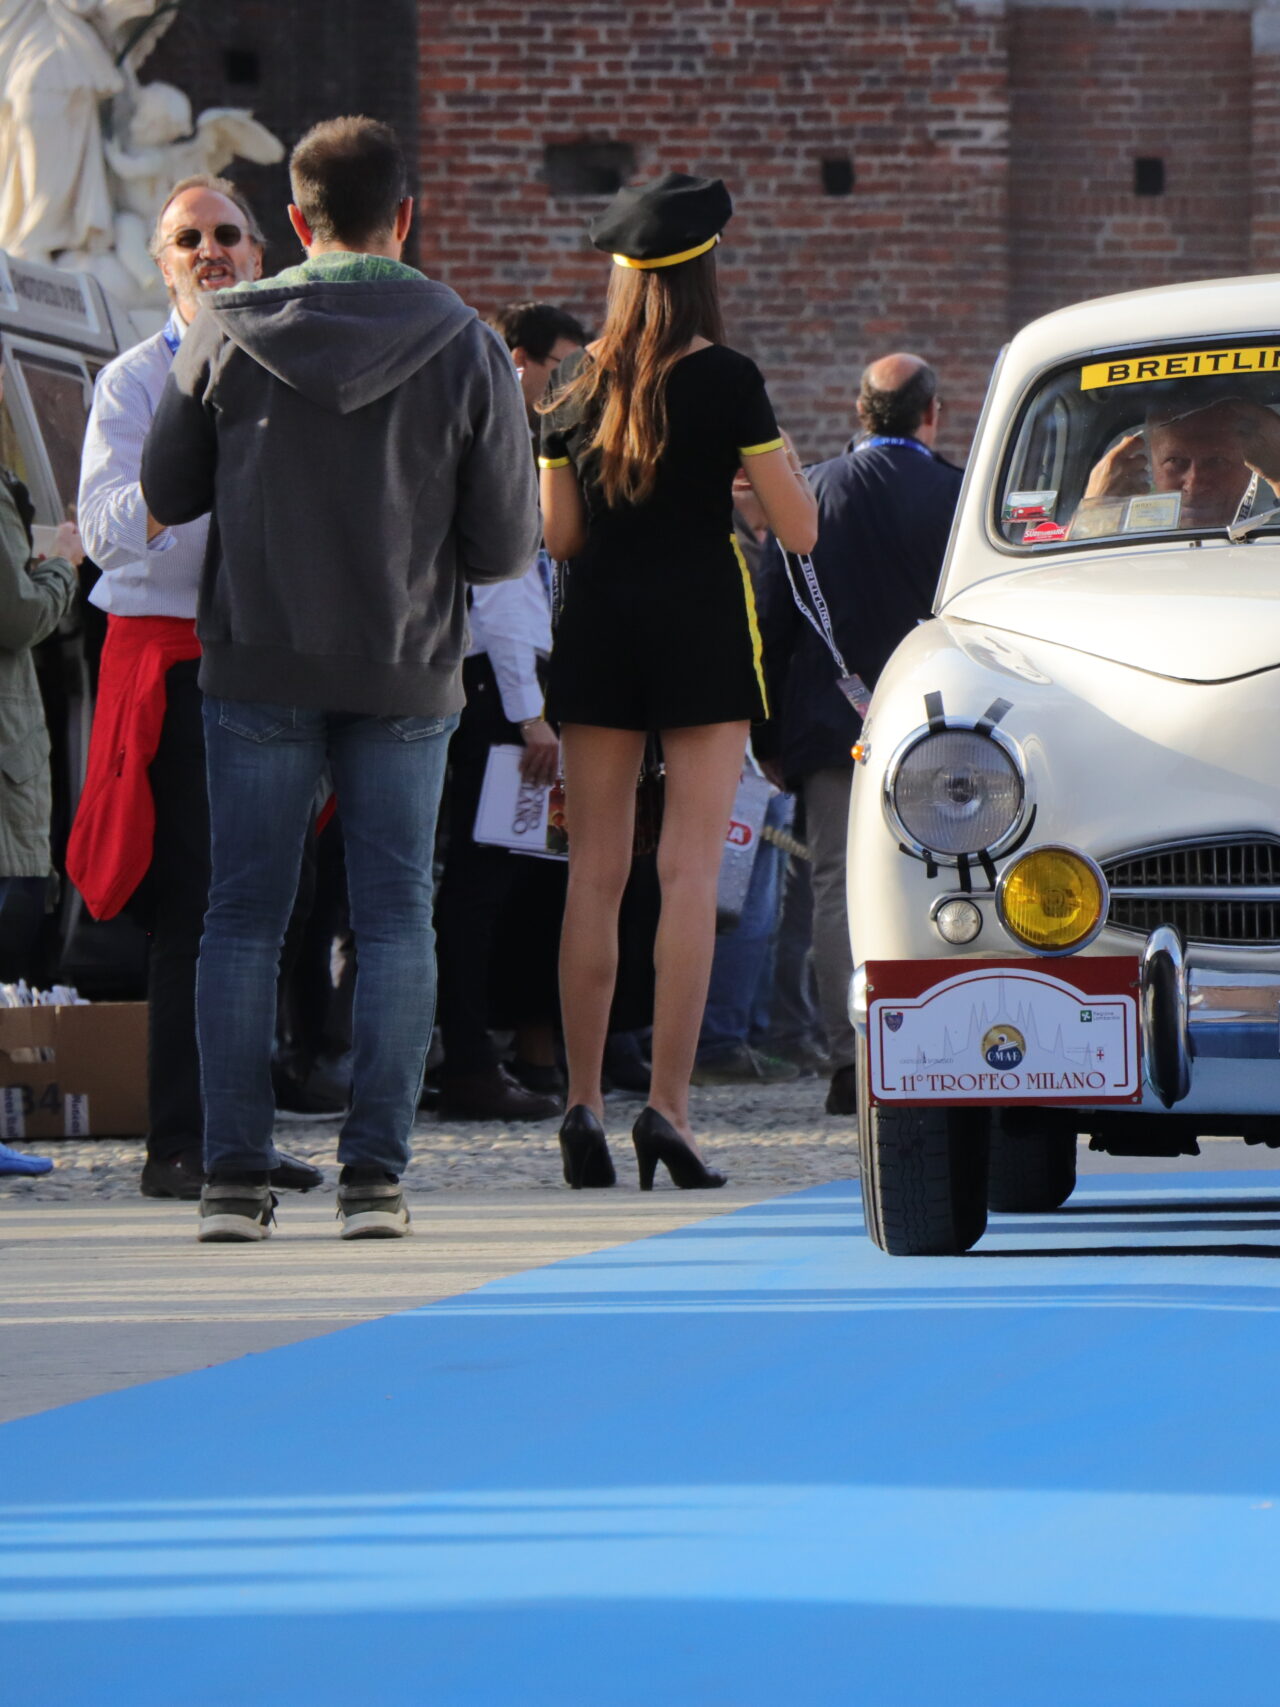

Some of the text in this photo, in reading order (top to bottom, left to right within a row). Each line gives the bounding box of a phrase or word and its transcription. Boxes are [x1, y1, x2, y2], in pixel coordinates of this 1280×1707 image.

[803, 562, 831, 629] BREITLING
[926, 1072, 1020, 1092] TROFEO
[1026, 1071, 1106, 1090] MILANO
